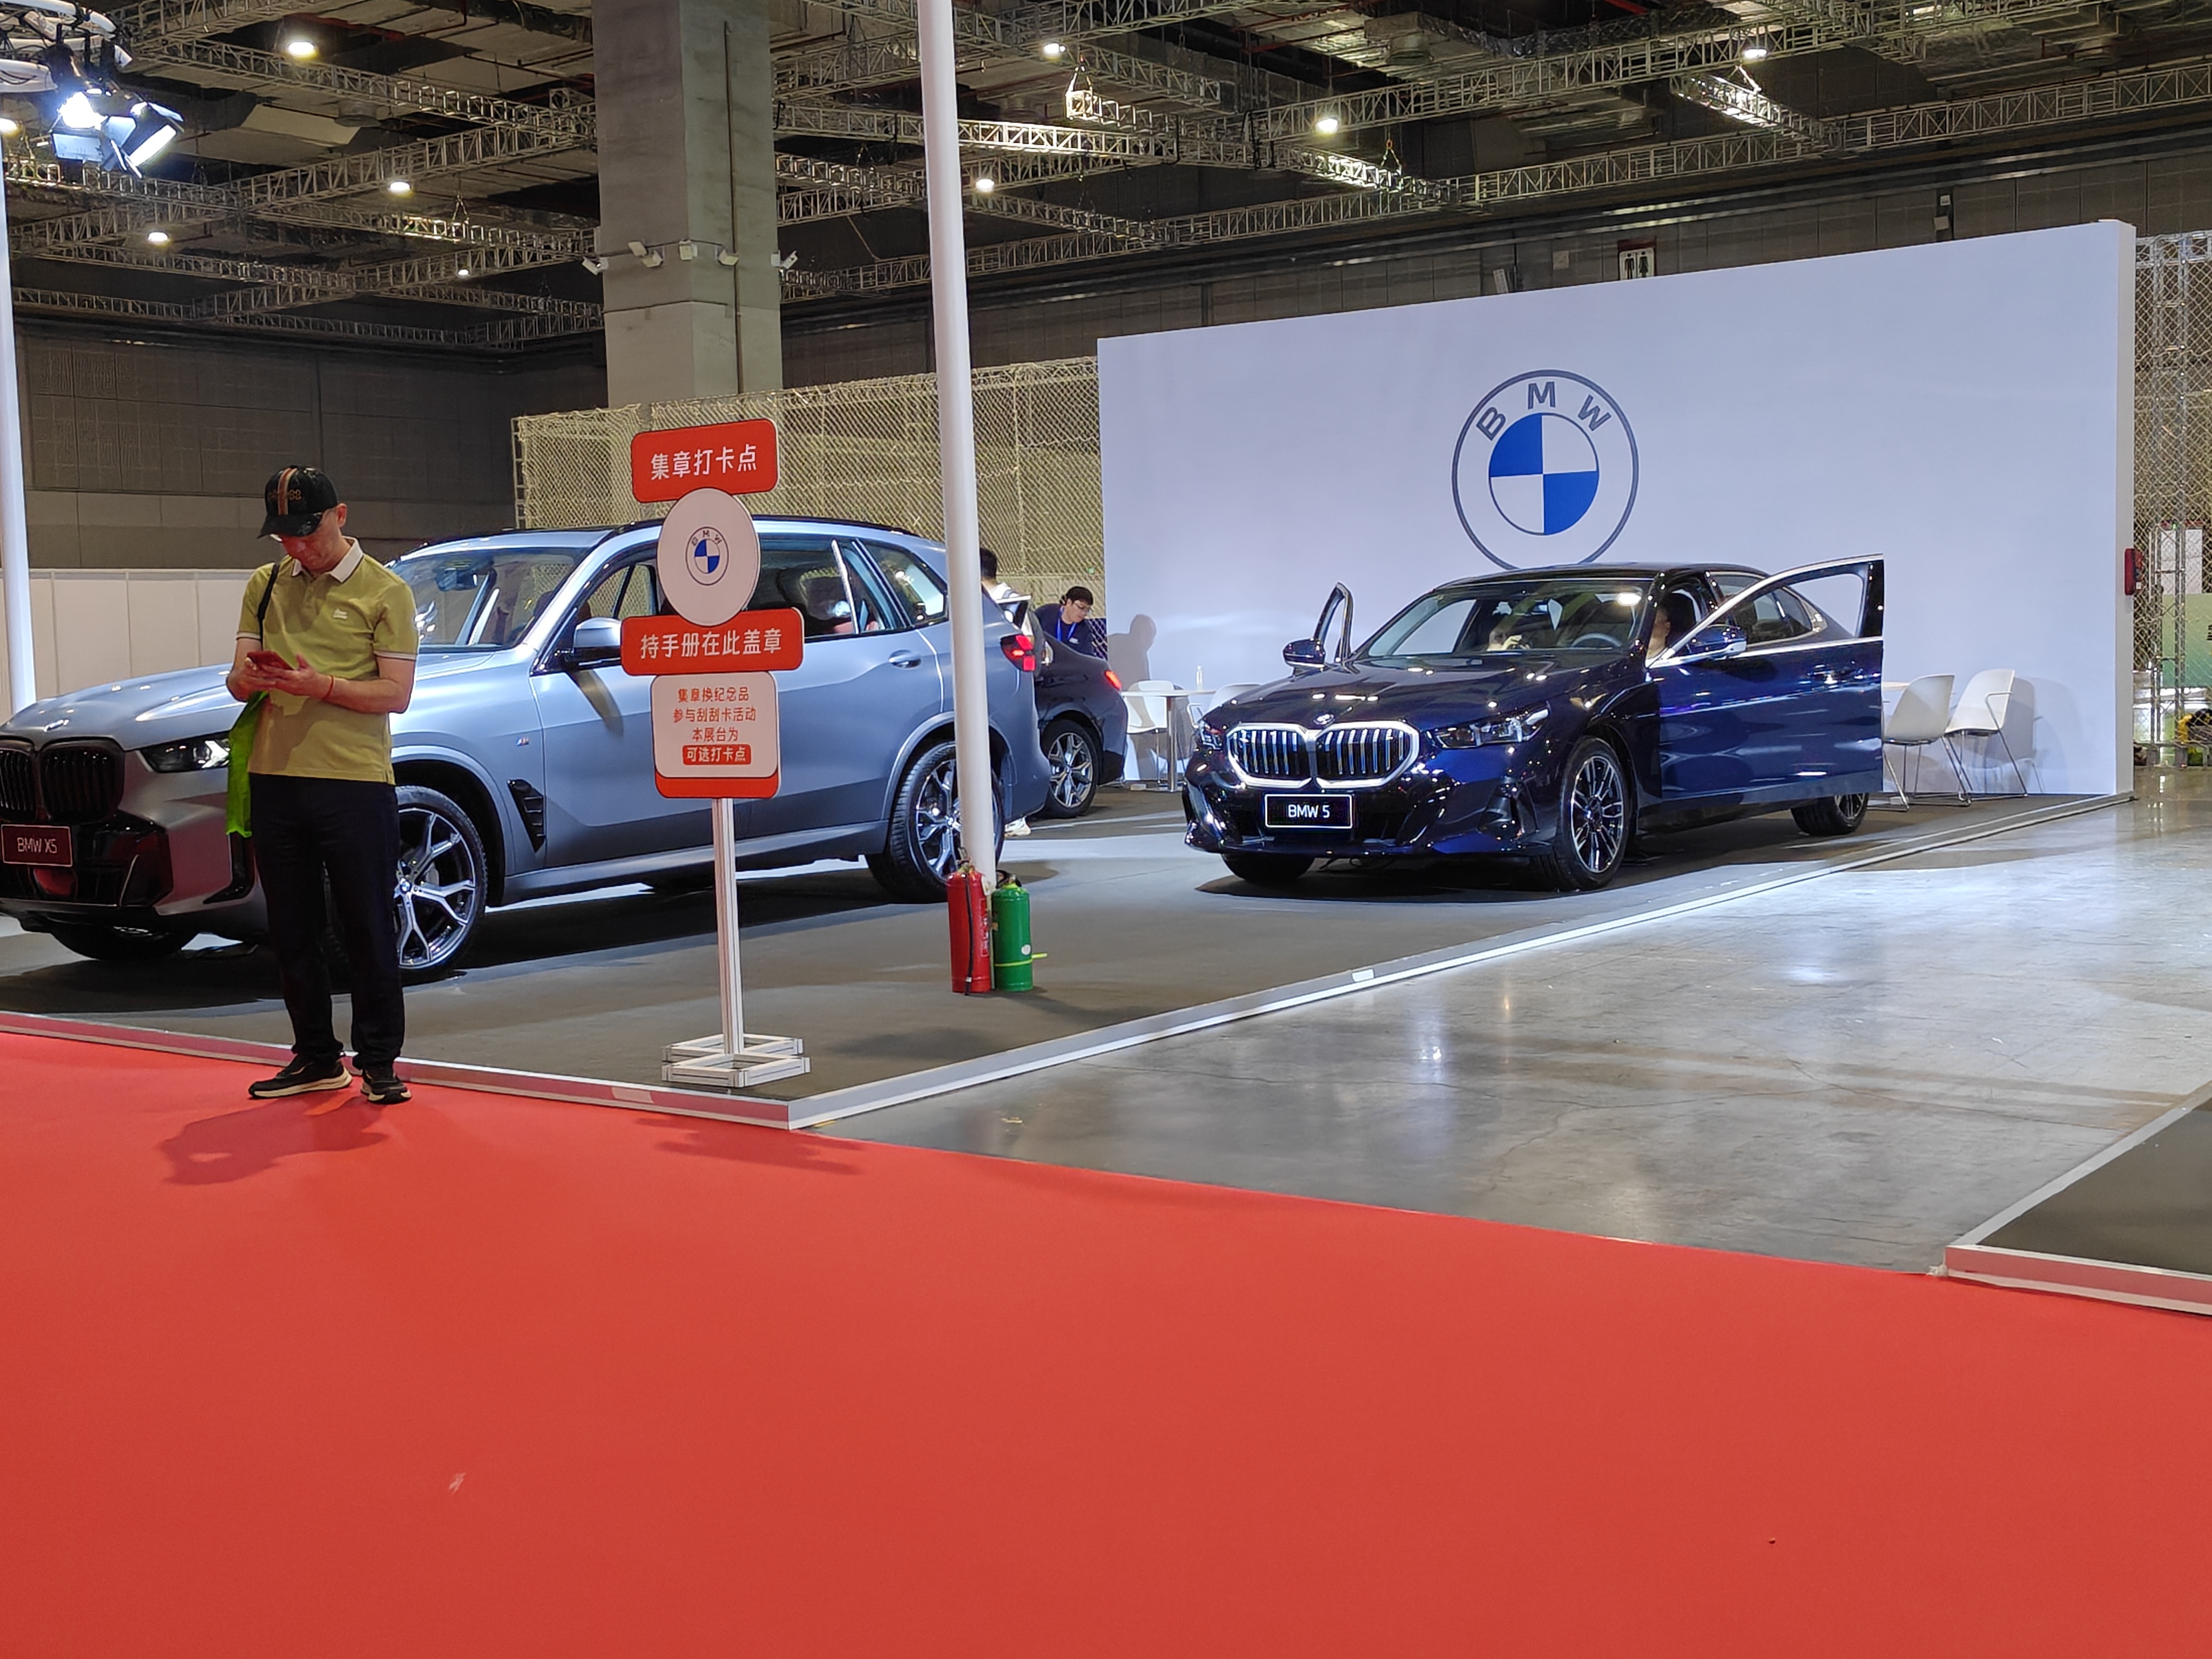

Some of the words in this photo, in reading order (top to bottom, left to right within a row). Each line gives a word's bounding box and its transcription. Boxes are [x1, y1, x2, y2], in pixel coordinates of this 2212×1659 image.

[1476, 381, 1611, 441] BMW
[650, 443, 757, 481] 集章打卡点
[691, 529, 723, 547] BMW
[640, 628, 783, 659] 持手册在此盖章
[677, 686, 750, 703] 集章换纪念品
[672, 706, 757, 723] 参与刮刮卡活动
[692, 726, 739, 743] 本展台为
[686, 746, 746, 763] 可选打卡点
[1288, 804, 1319, 818] BMW
[1323, 805, 1330, 818] 5
[17, 837, 42, 852] BMW
[44, 838, 57, 853] X5
